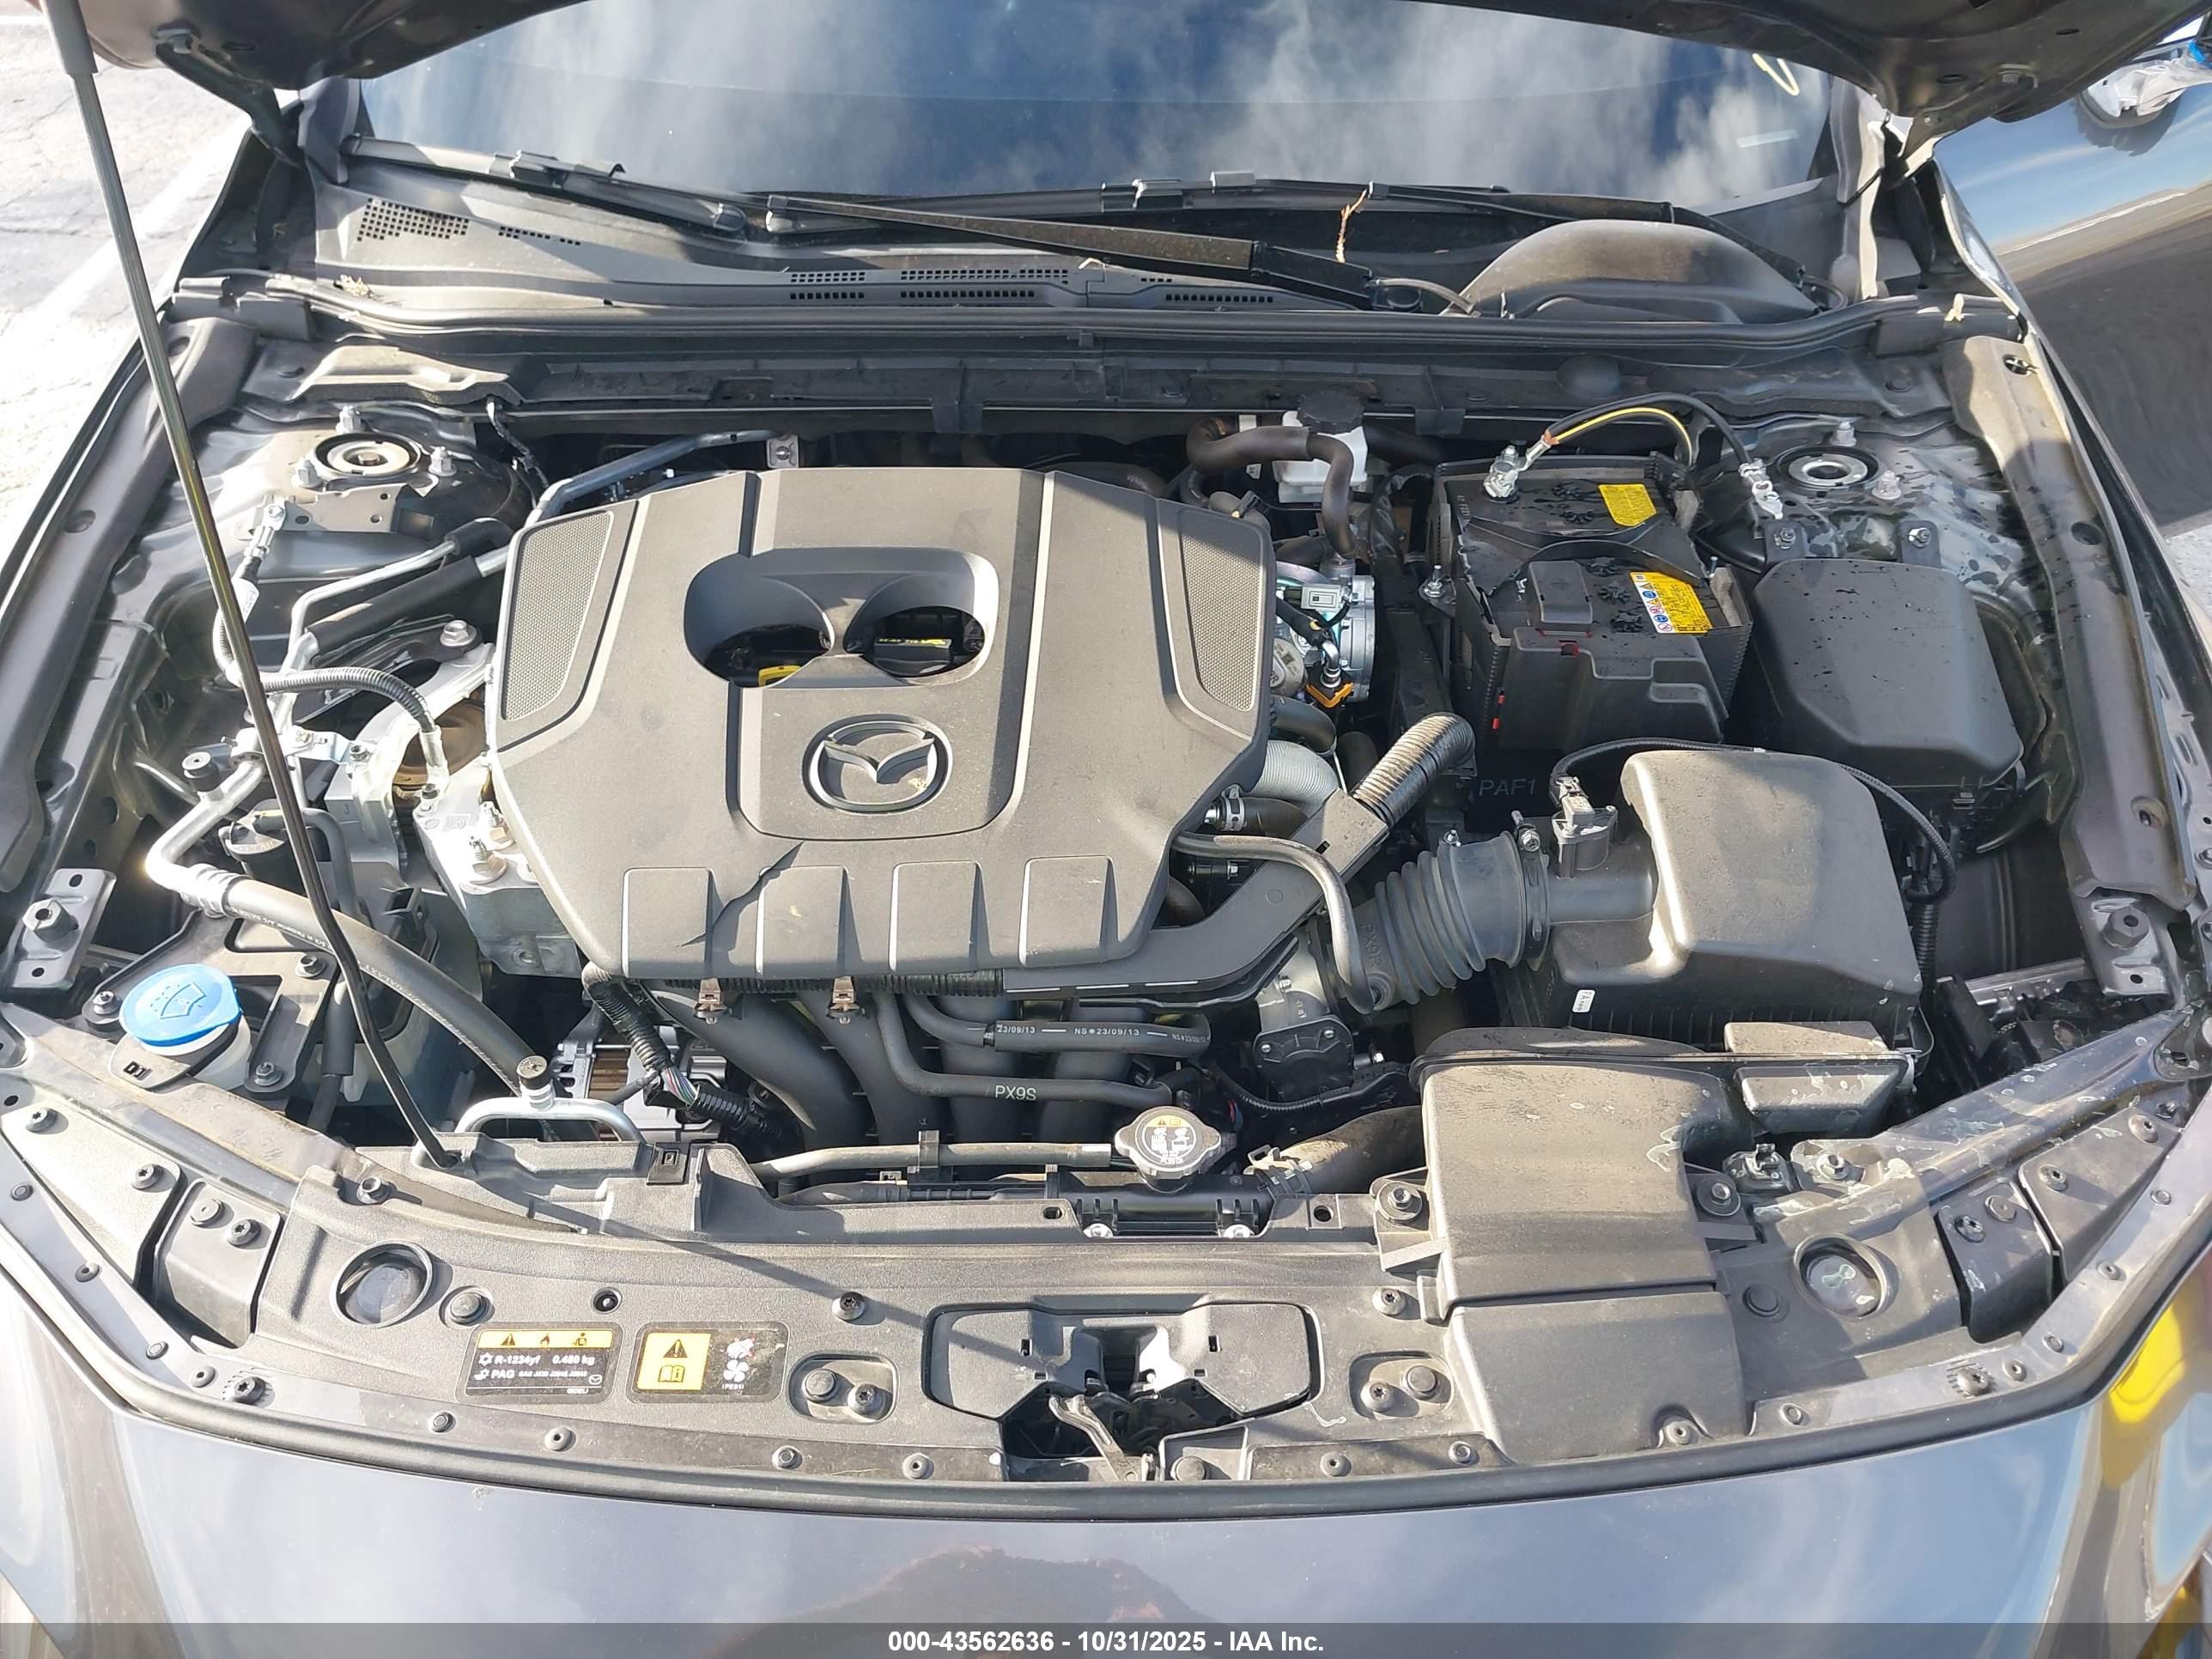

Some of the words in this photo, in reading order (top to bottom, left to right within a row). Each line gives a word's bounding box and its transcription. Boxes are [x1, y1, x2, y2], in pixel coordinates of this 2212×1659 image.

[1479, 778, 1535, 796] PAF1
[994, 1085, 1037, 1101] PX9S
[581, 1354, 595, 1366] kg
[490, 1369, 515, 1379] PAG
